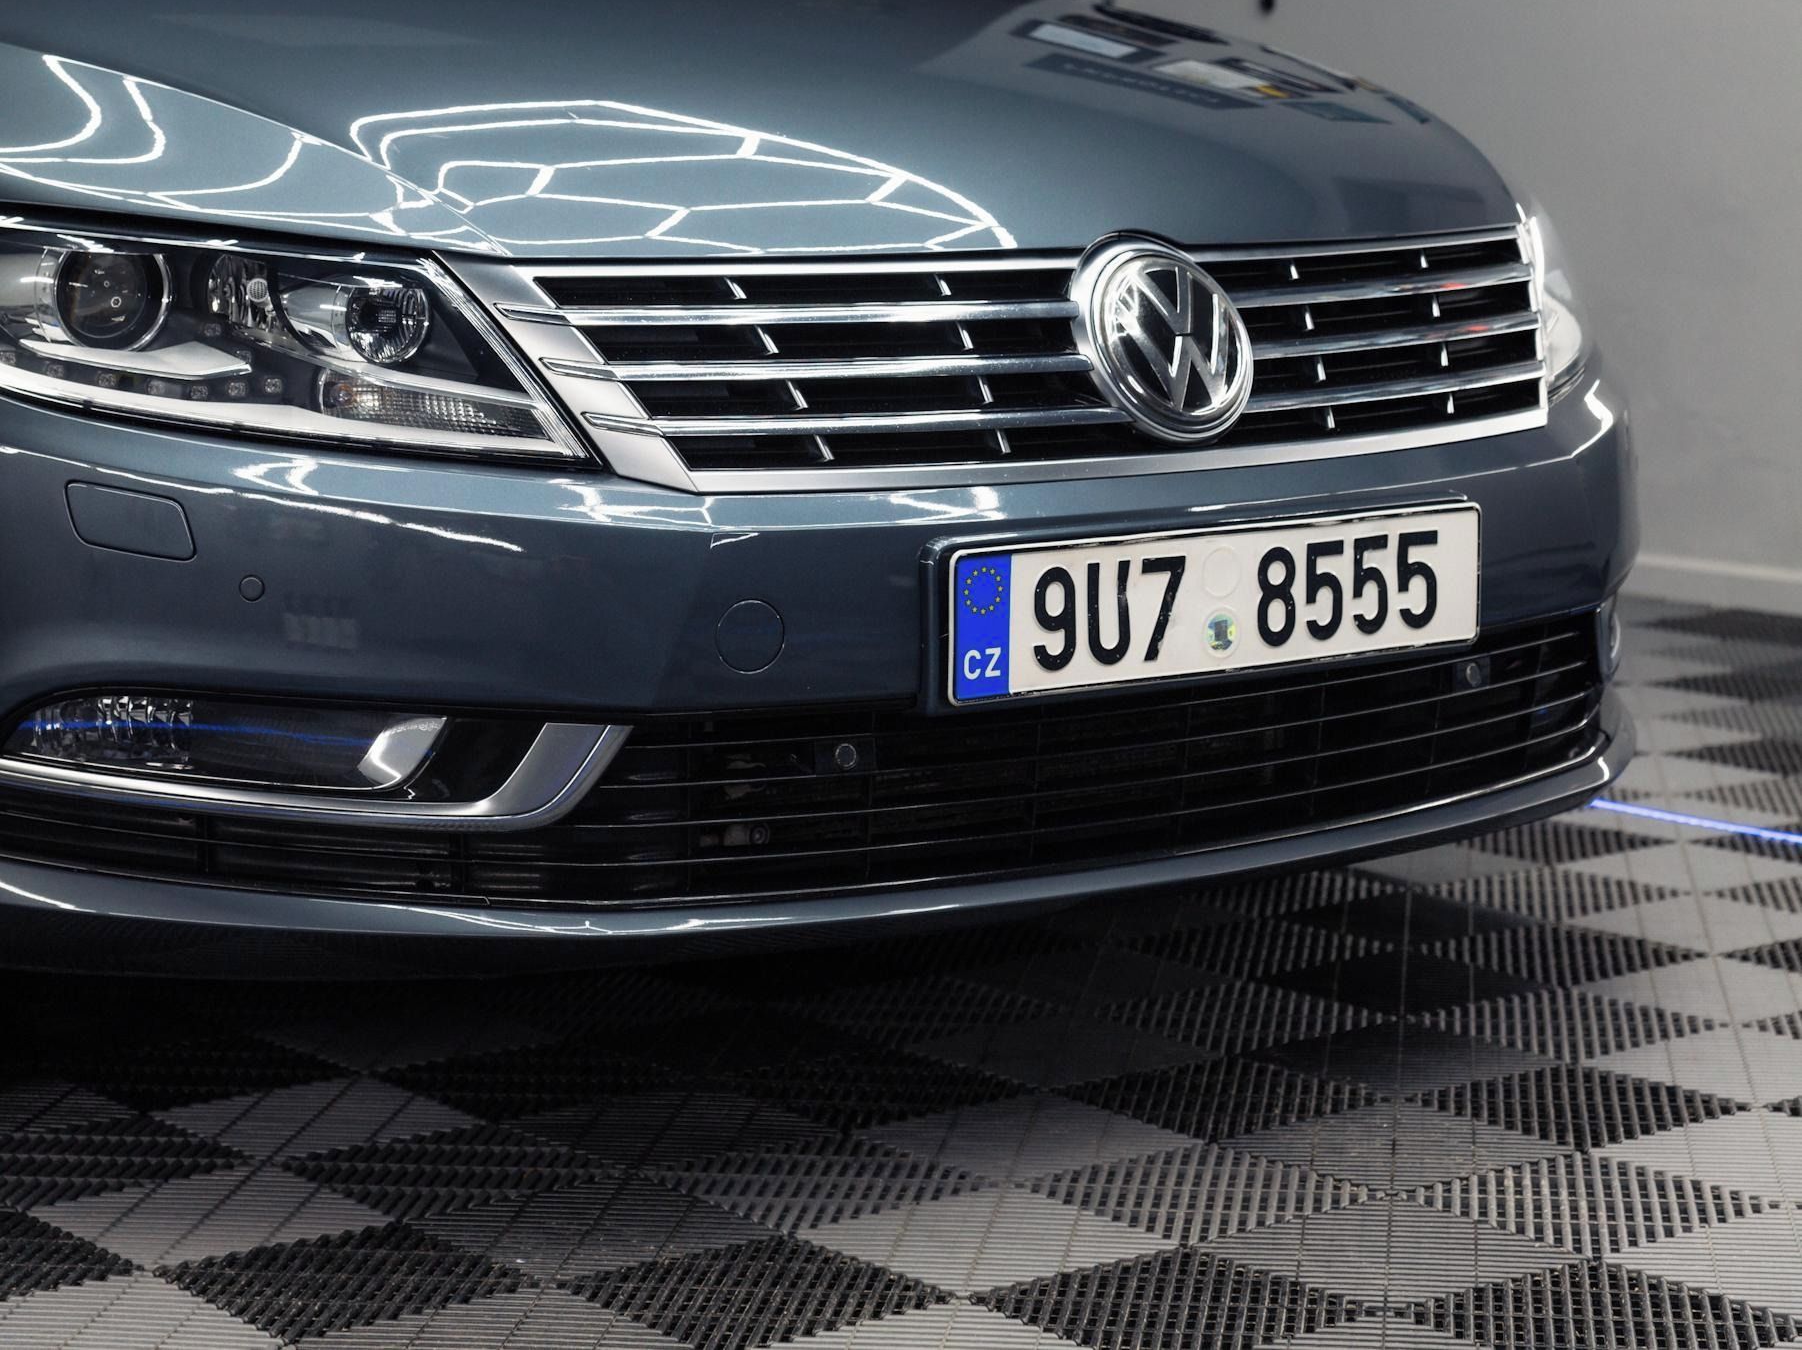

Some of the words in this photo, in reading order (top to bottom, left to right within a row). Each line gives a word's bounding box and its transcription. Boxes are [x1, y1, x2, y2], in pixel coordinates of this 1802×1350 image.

[1033, 554, 1188, 672] 9U7
[1256, 529, 1440, 648] 8555
[963, 646, 1002, 681] CZ
